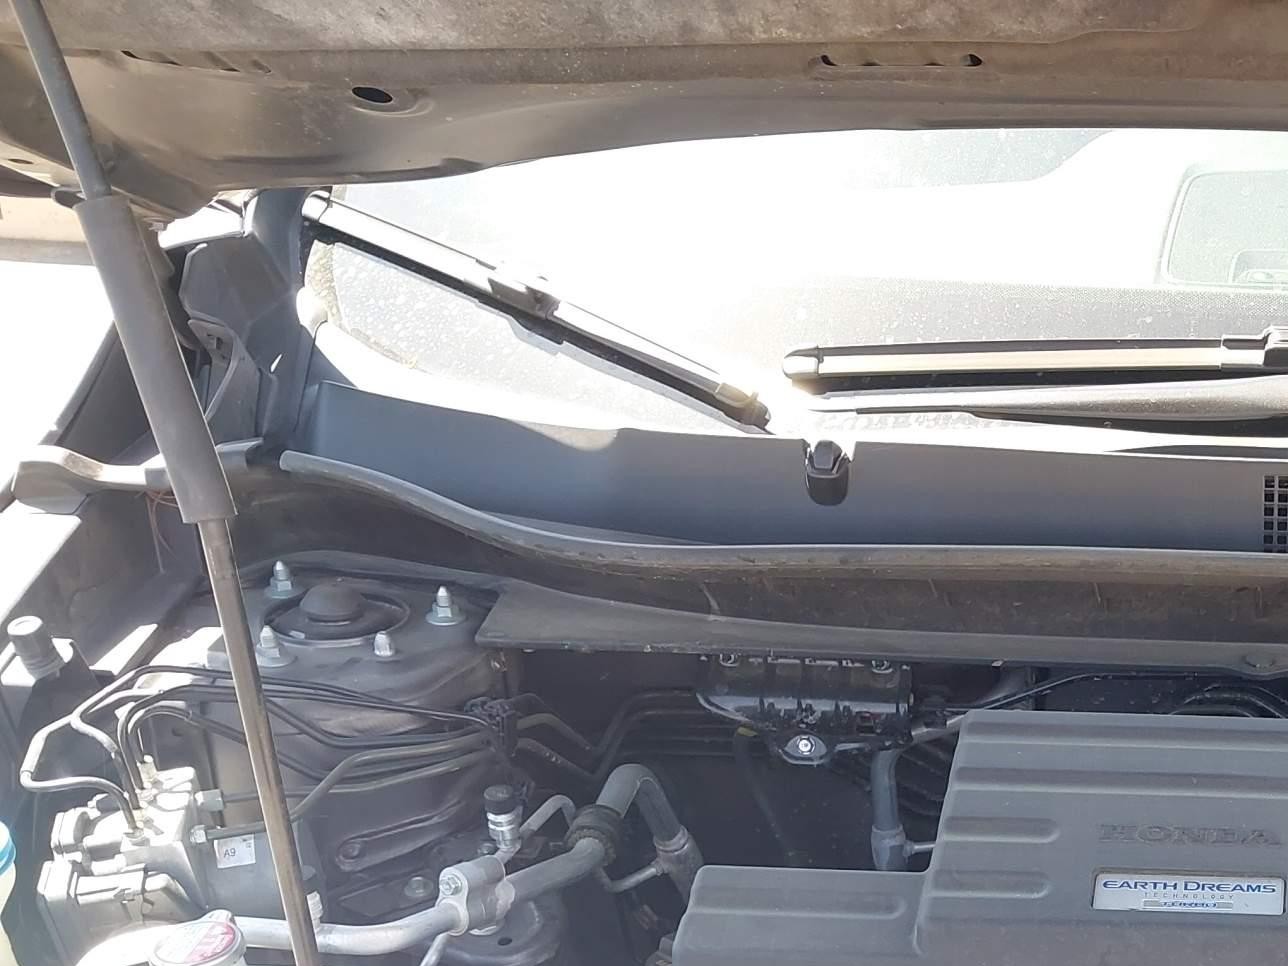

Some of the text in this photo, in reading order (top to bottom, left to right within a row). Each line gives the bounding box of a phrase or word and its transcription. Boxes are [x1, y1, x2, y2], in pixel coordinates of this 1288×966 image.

[1098, 824, 1282, 846] HONDA
[1102, 880, 1277, 893] EARTH DREAMS
[1144, 892, 1235, 900] TECHNOLOGY
